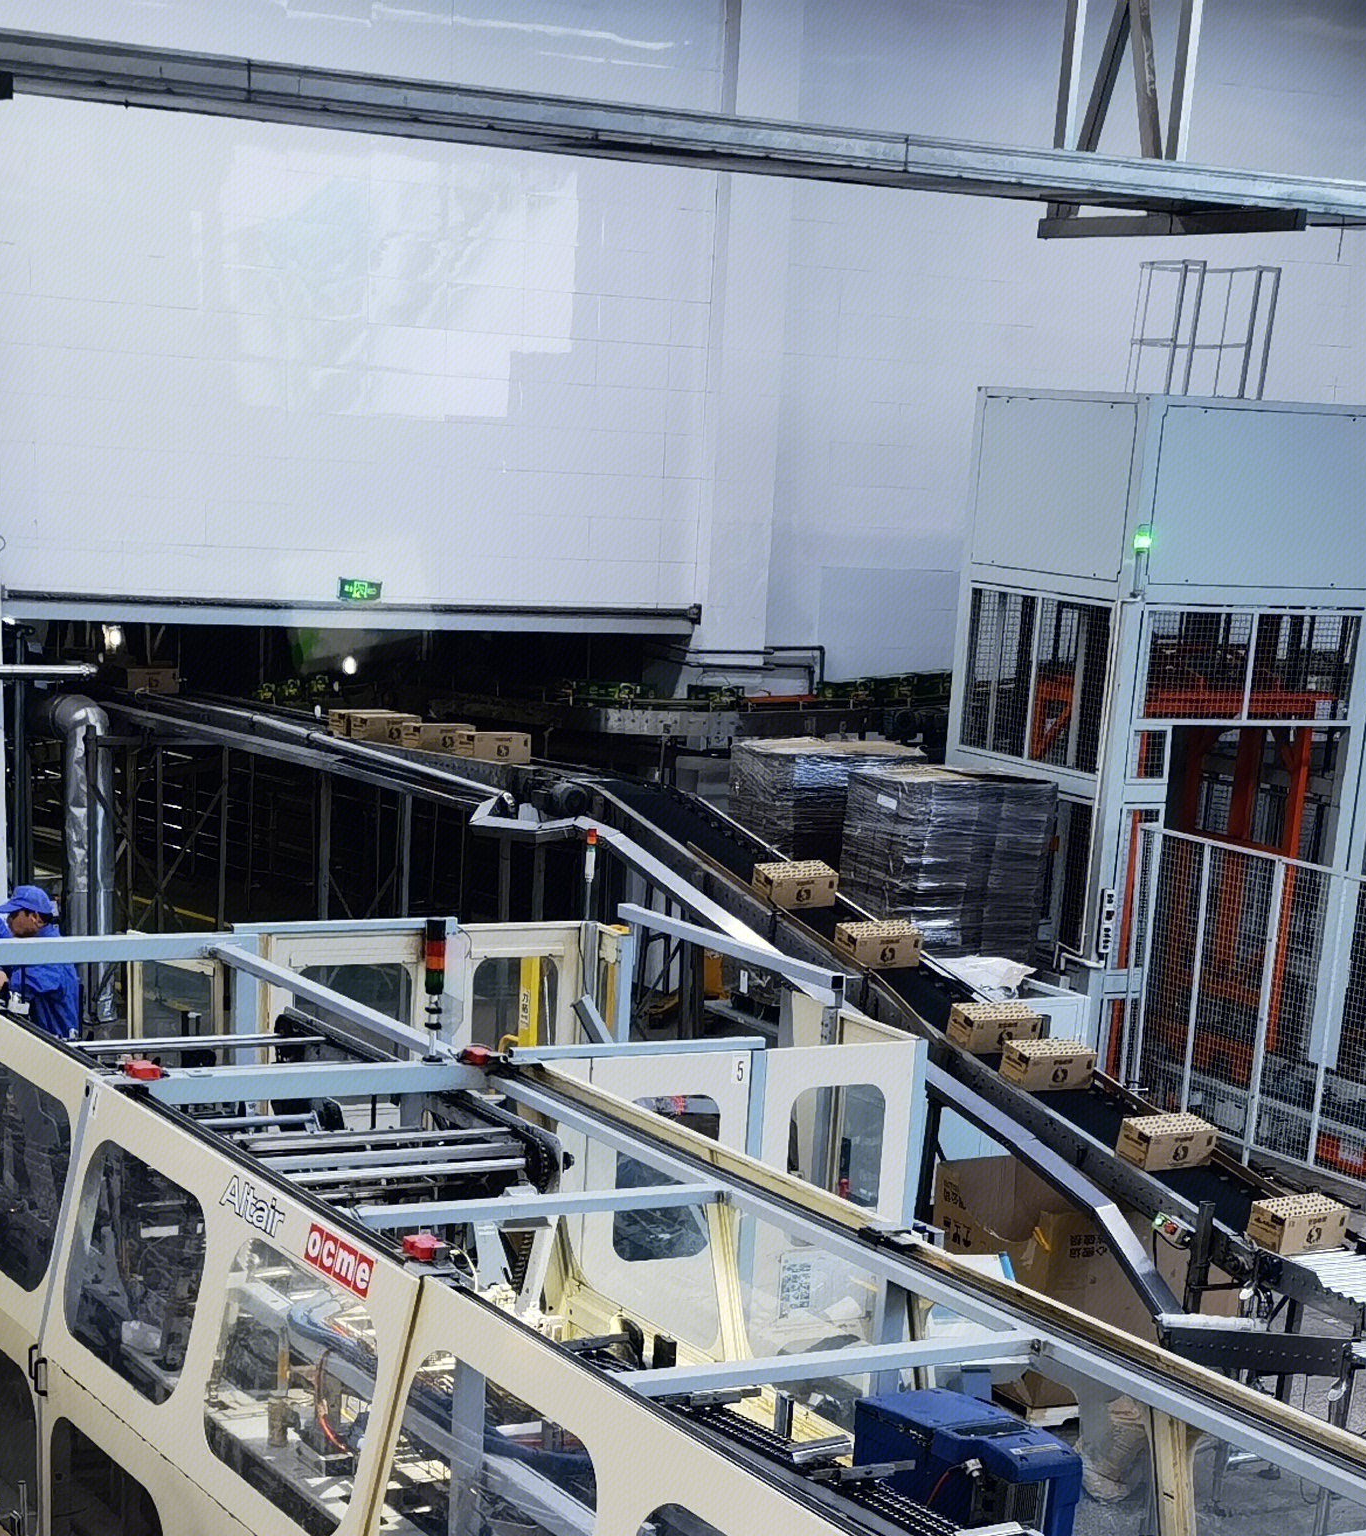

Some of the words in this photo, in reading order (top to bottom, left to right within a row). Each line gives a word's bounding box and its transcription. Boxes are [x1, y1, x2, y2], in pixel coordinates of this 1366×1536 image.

[736, 1060, 745, 1082] 5
[219, 1175, 286, 1238] Altair
[306, 1229, 372, 1290] ocme
